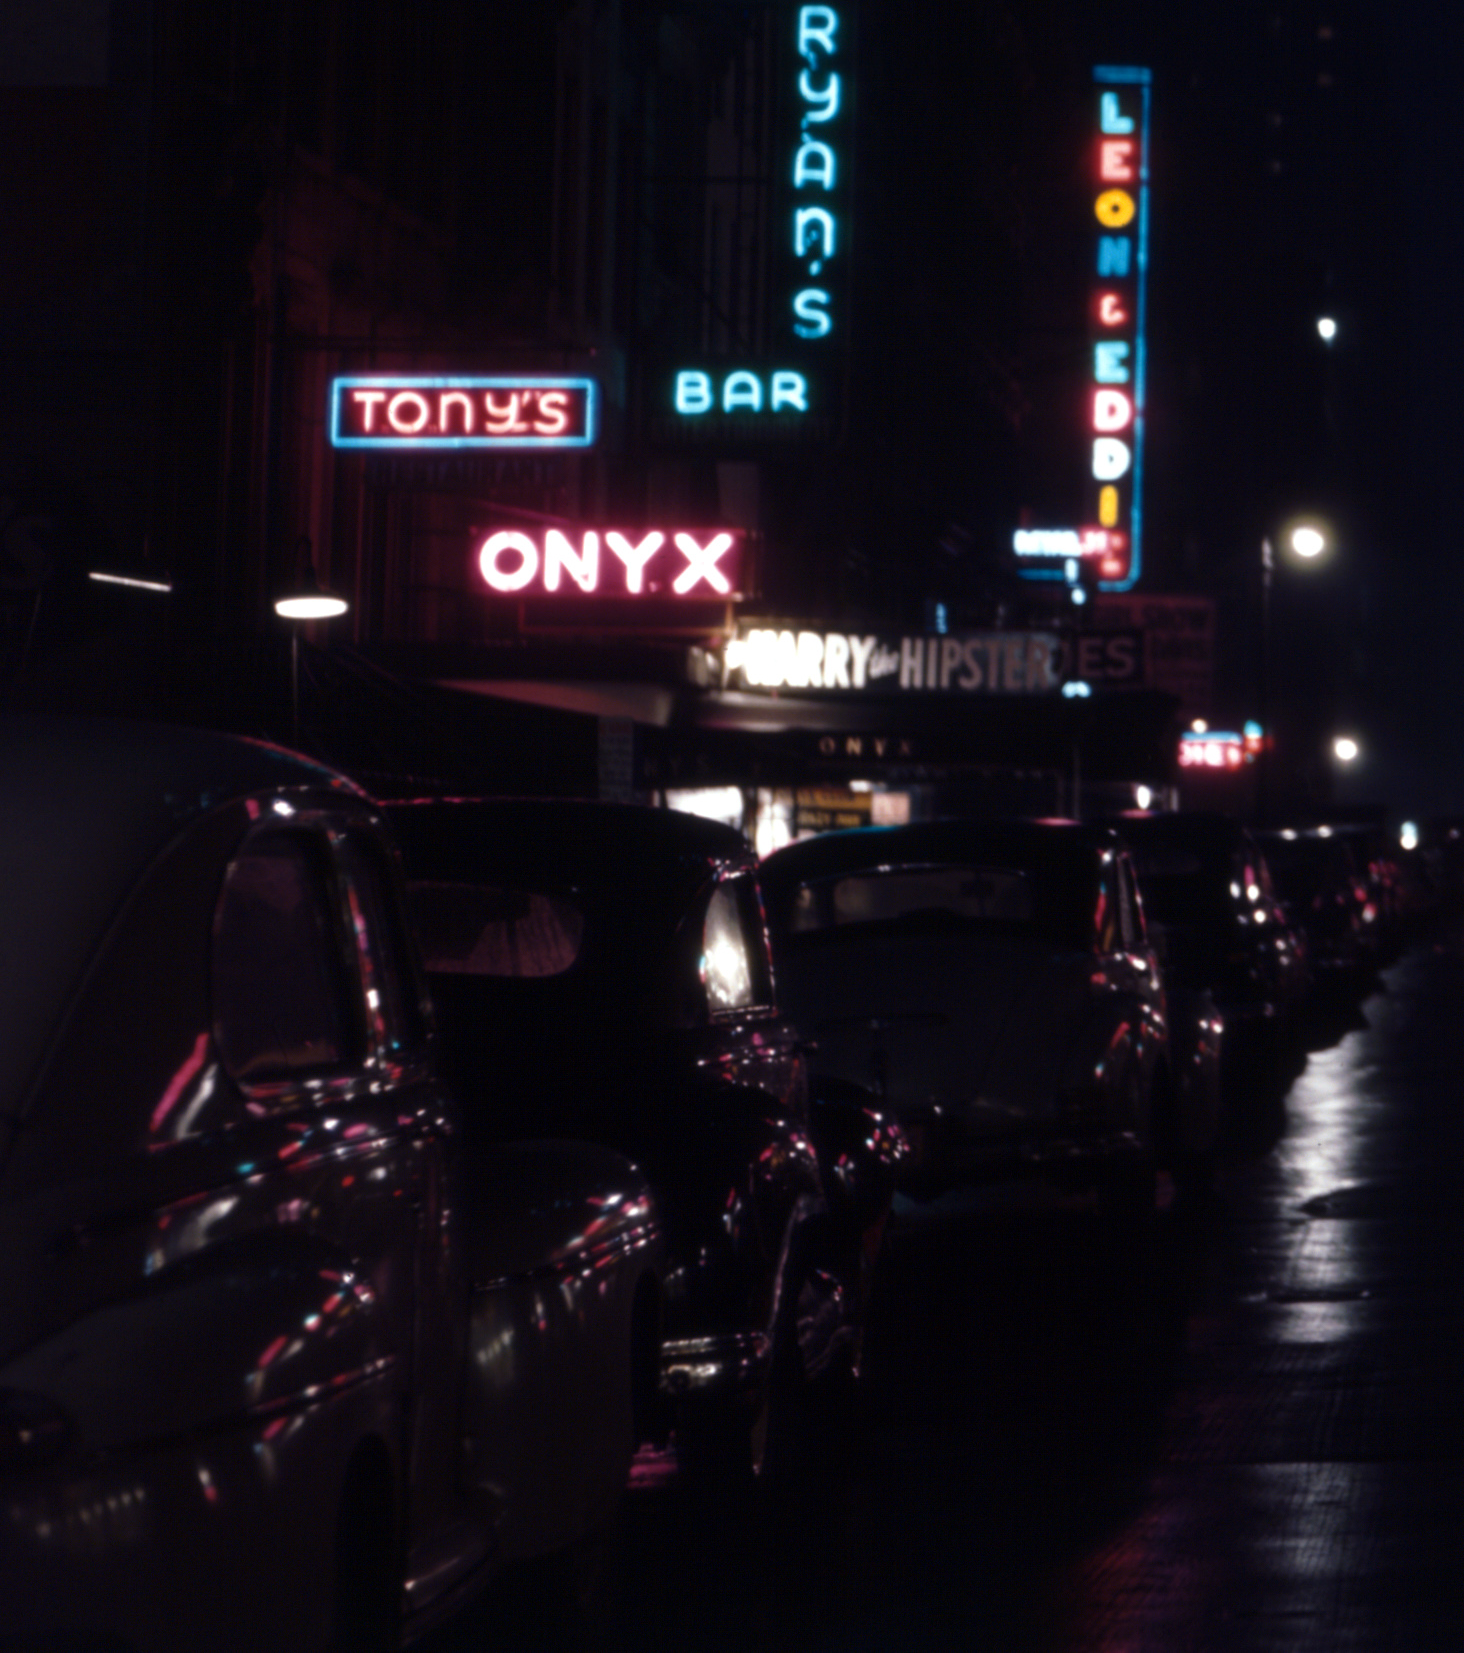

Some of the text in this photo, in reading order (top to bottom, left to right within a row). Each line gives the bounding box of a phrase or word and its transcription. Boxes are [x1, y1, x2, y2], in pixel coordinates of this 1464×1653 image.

[1095, 91, 1136, 276] LEON
[675, 370, 808, 414] BAR
[479, 529, 734, 595] ONYX
[745, 629, 876, 689] HARRY
[900, 636, 1052, 690] HIPSTER
